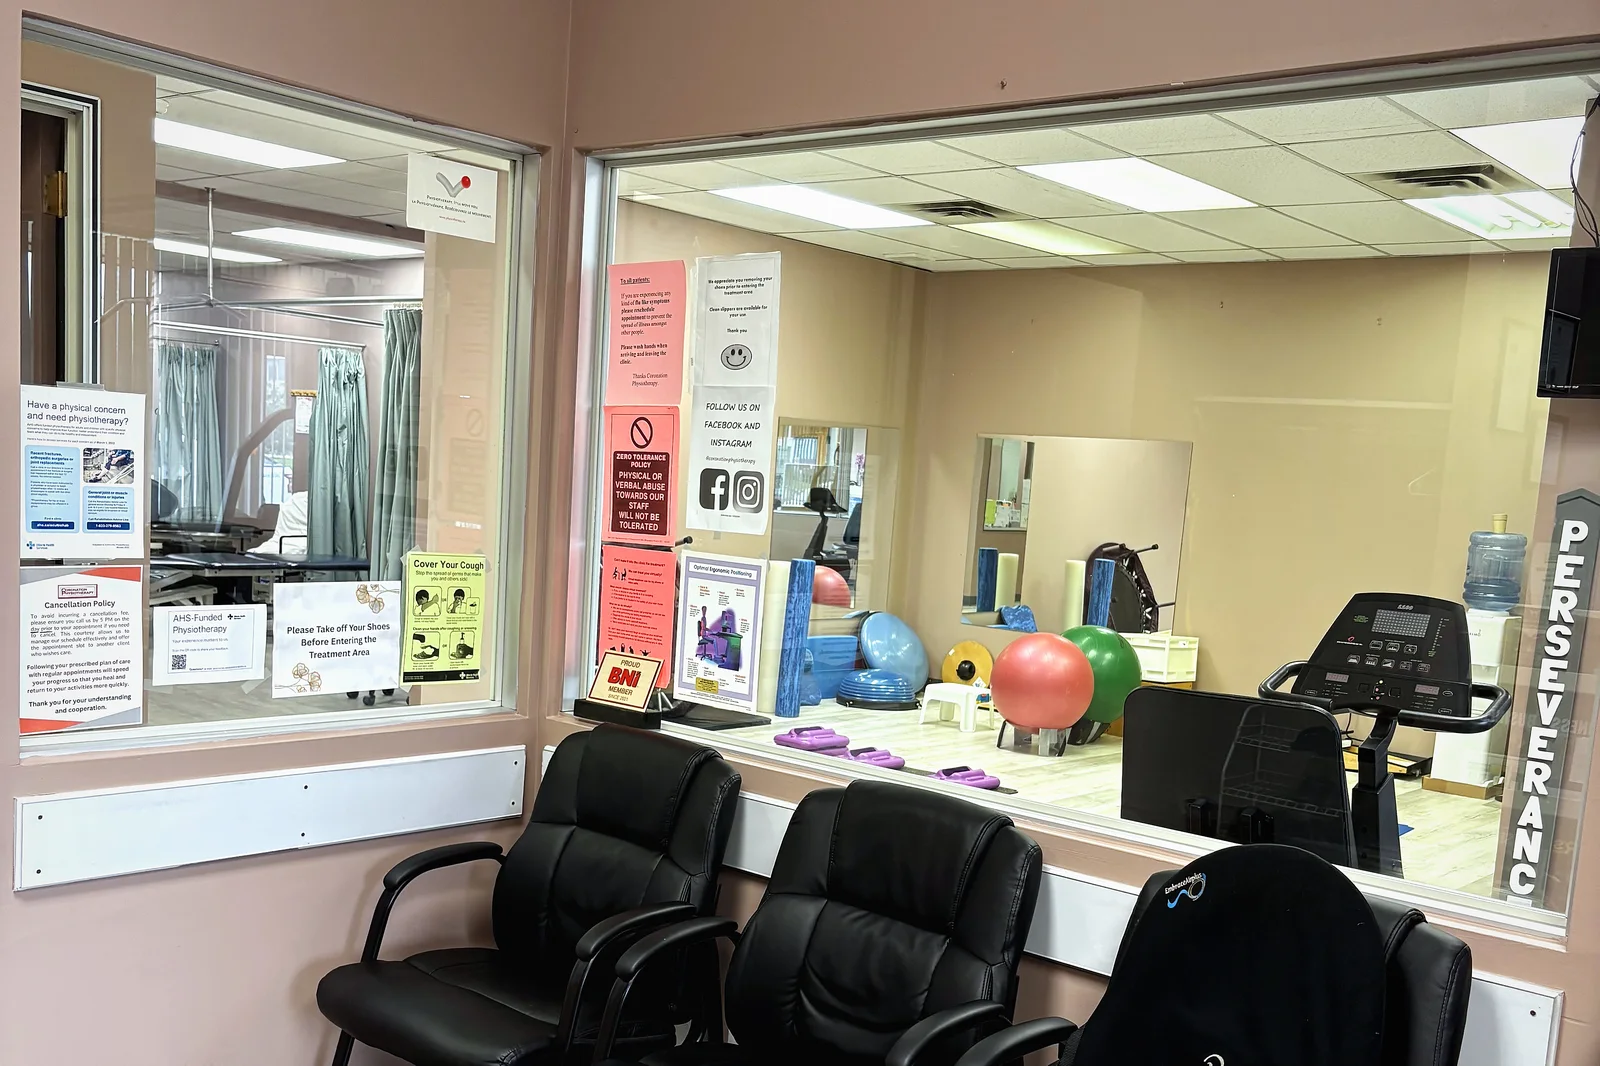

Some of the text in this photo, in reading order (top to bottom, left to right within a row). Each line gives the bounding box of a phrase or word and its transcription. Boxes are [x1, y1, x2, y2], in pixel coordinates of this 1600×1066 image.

[27, 400, 49, 409] Have
[59, 404, 92, 412] physical
[69, 416, 128, 426] physiotherapy?
[704, 421, 742, 429] FACEBOOK
[616, 491, 648, 499] TOWARDS
[620, 521, 658, 530] TOLERATED
[414, 560, 438, 568] Cover
[460, 561, 484, 571] Cough
[336, 624, 348, 632] off
[620, 659, 641, 668] PROUD
[608, 686, 633, 696] MEMBER
[1507, 520, 1589, 907] PERSEVERANC
